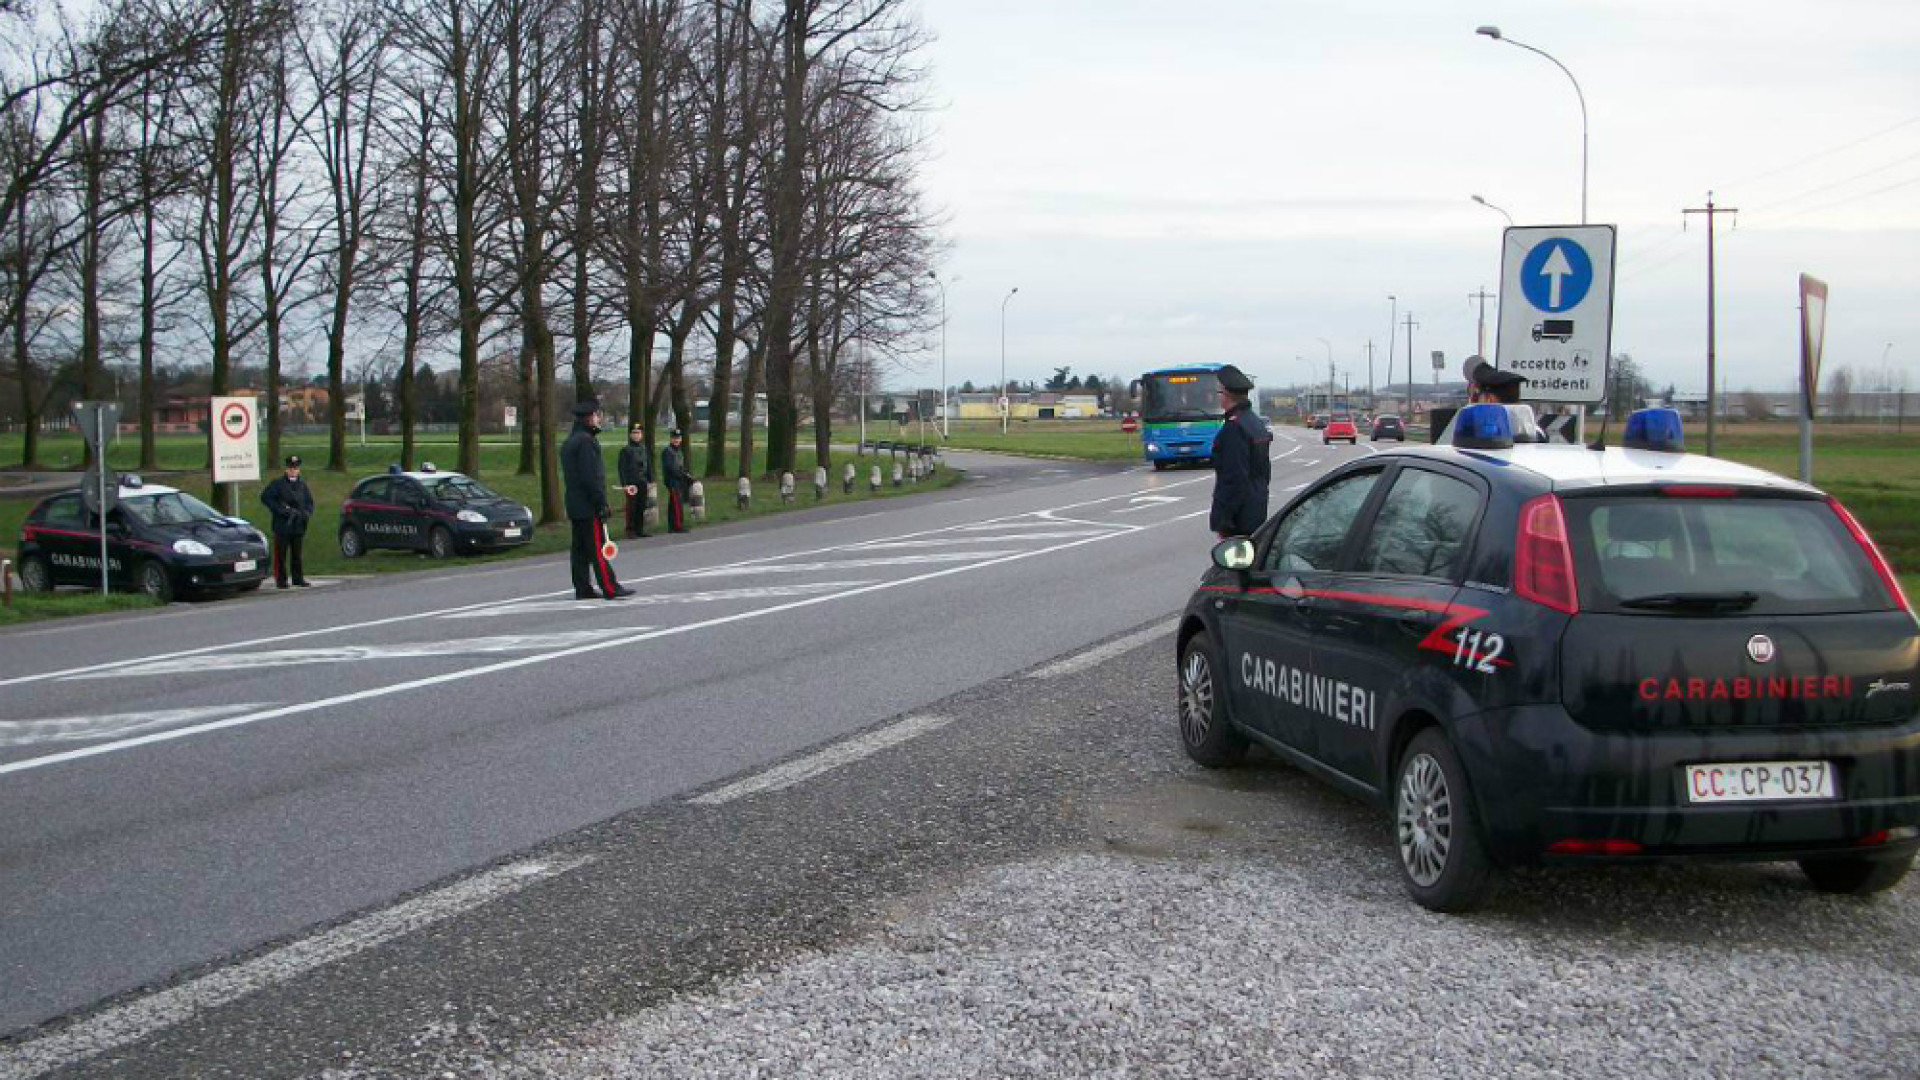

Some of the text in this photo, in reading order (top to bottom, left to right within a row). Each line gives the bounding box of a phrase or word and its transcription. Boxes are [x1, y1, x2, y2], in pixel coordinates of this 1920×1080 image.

[1510, 358, 1566, 371] eccetto
[1524, 378, 1589, 390] residenti
[1453, 626, 1504, 674] 112
[1241, 651, 1376, 732] CARABINIERI
[1638, 674, 1852, 699] CARABINIERI
